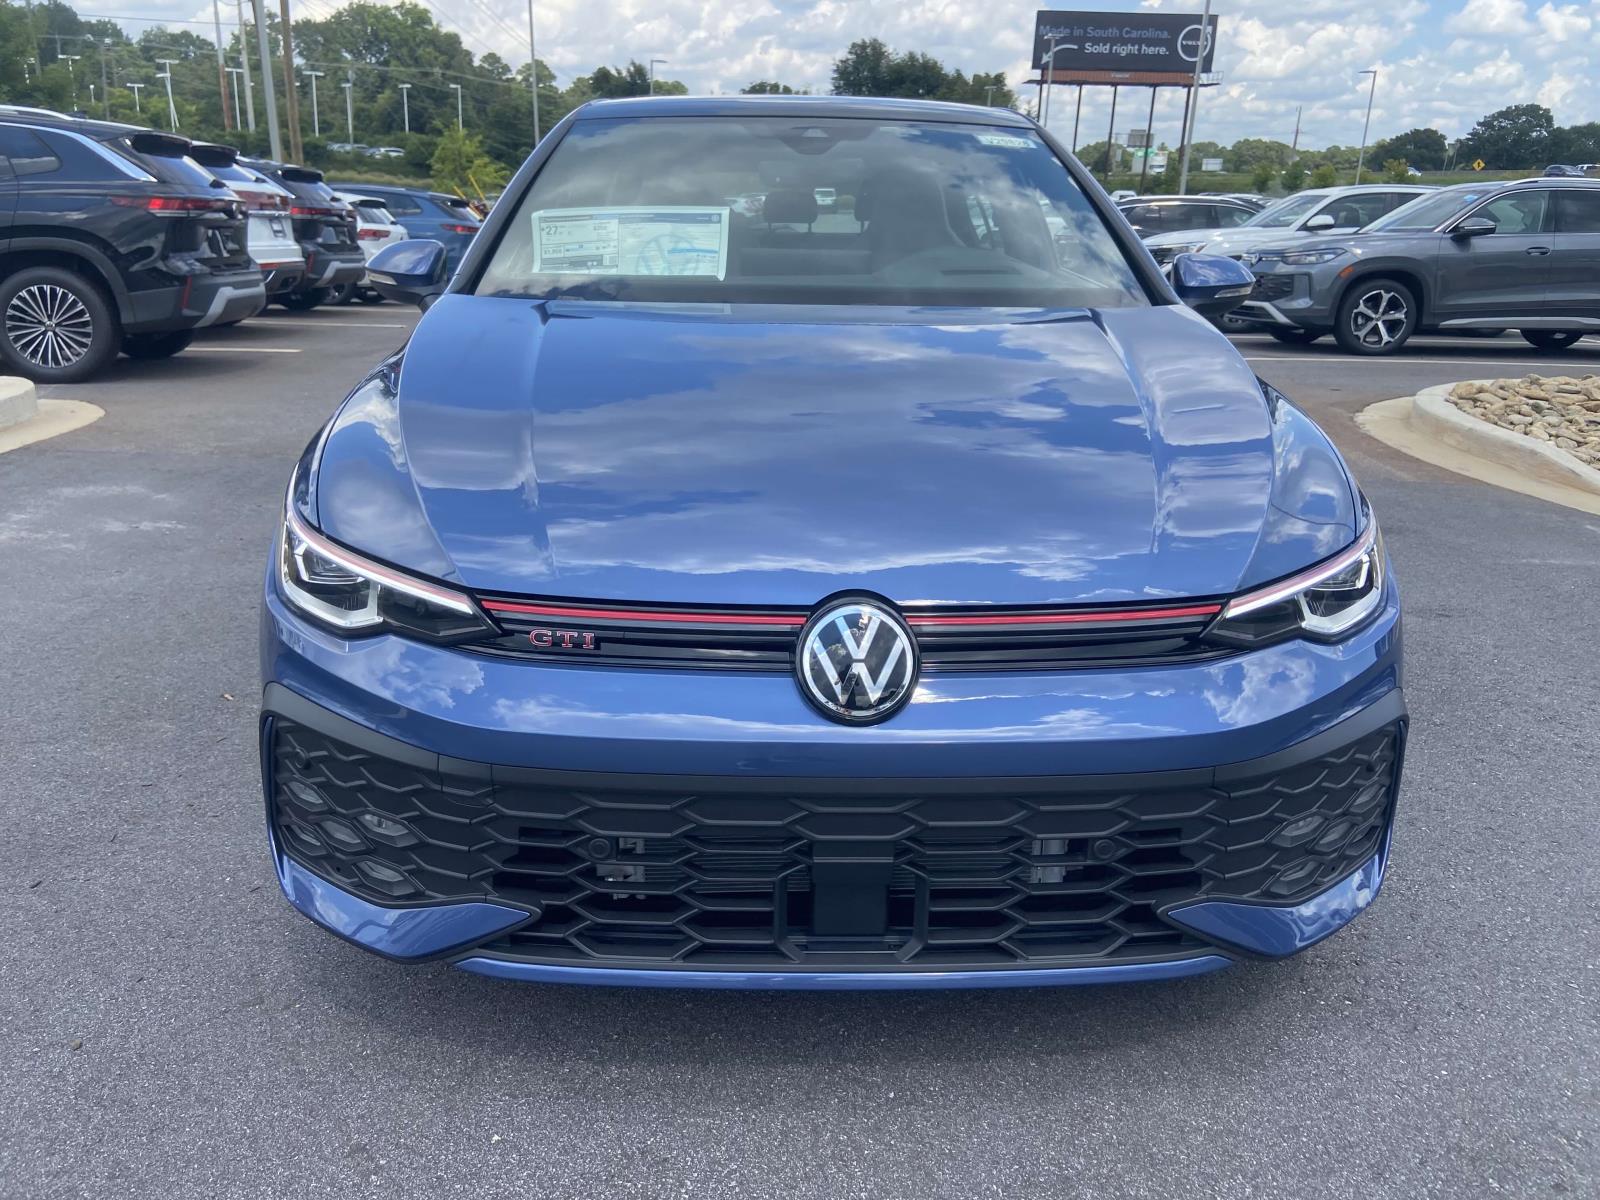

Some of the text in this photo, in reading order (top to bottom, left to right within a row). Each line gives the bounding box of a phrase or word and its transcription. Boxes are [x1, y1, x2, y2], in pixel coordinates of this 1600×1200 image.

[1040, 25, 1171, 38] Made in South Carolina.
[1084, 42, 1169, 56] Sold right here.
[545, 225, 558, 235] 27
[529, 628, 595, 649] GTI
